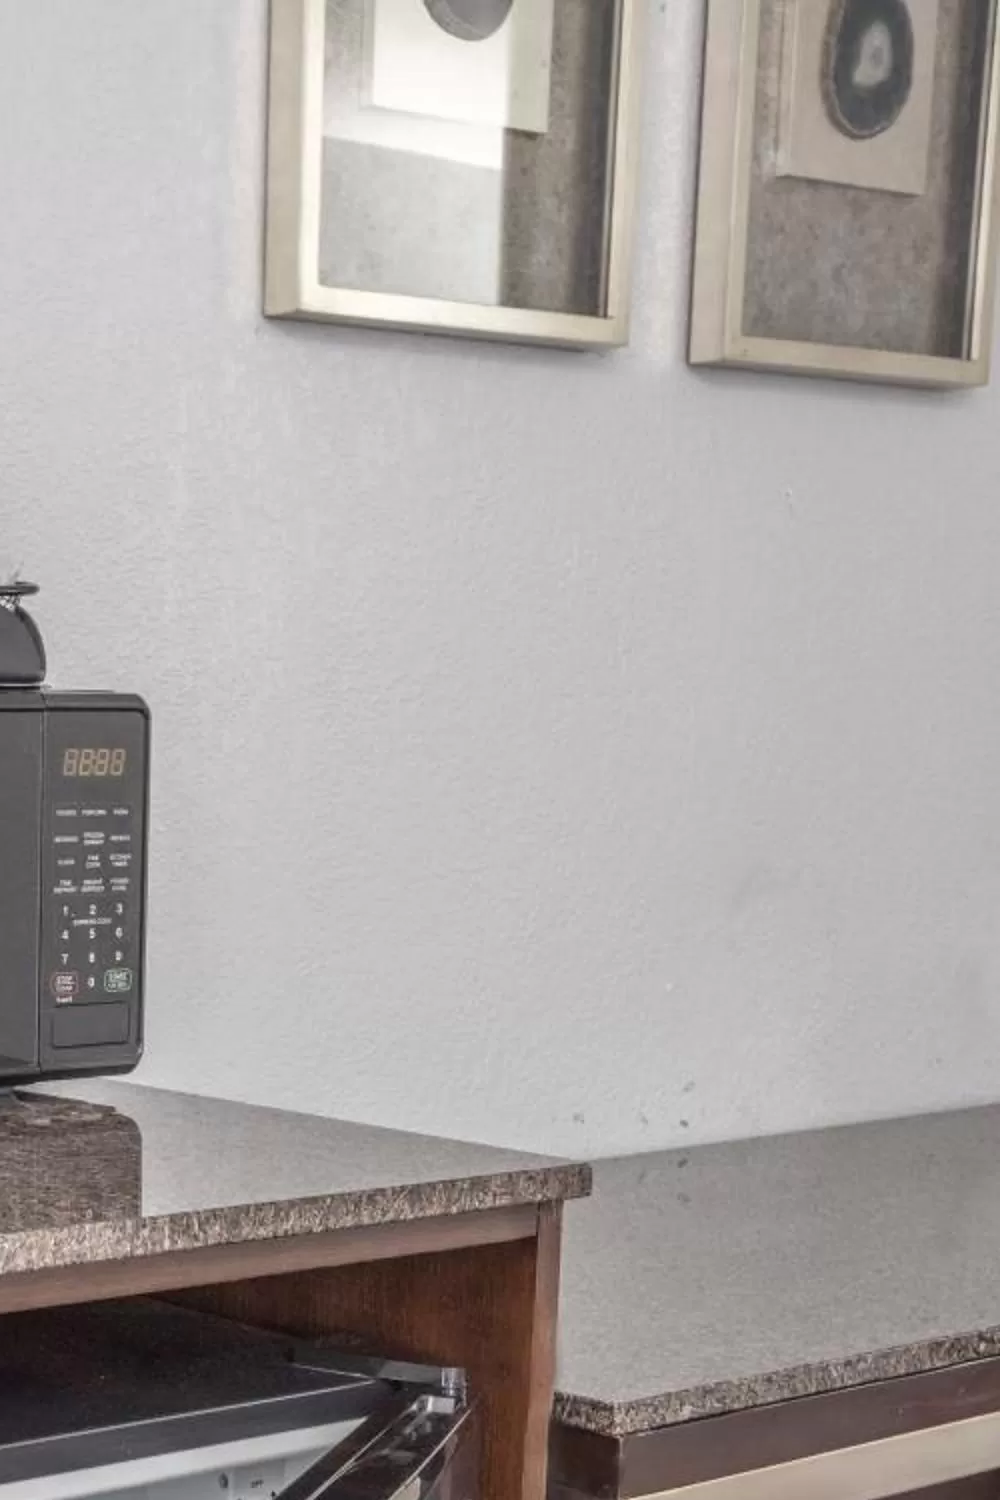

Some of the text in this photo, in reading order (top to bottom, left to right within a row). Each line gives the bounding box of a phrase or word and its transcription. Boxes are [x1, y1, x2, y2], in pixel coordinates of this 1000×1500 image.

[89, 903, 97, 915] 2
[61, 929, 69, 940] 4
[89, 928, 96, 939] 5
[61, 953, 69, 965] 7
